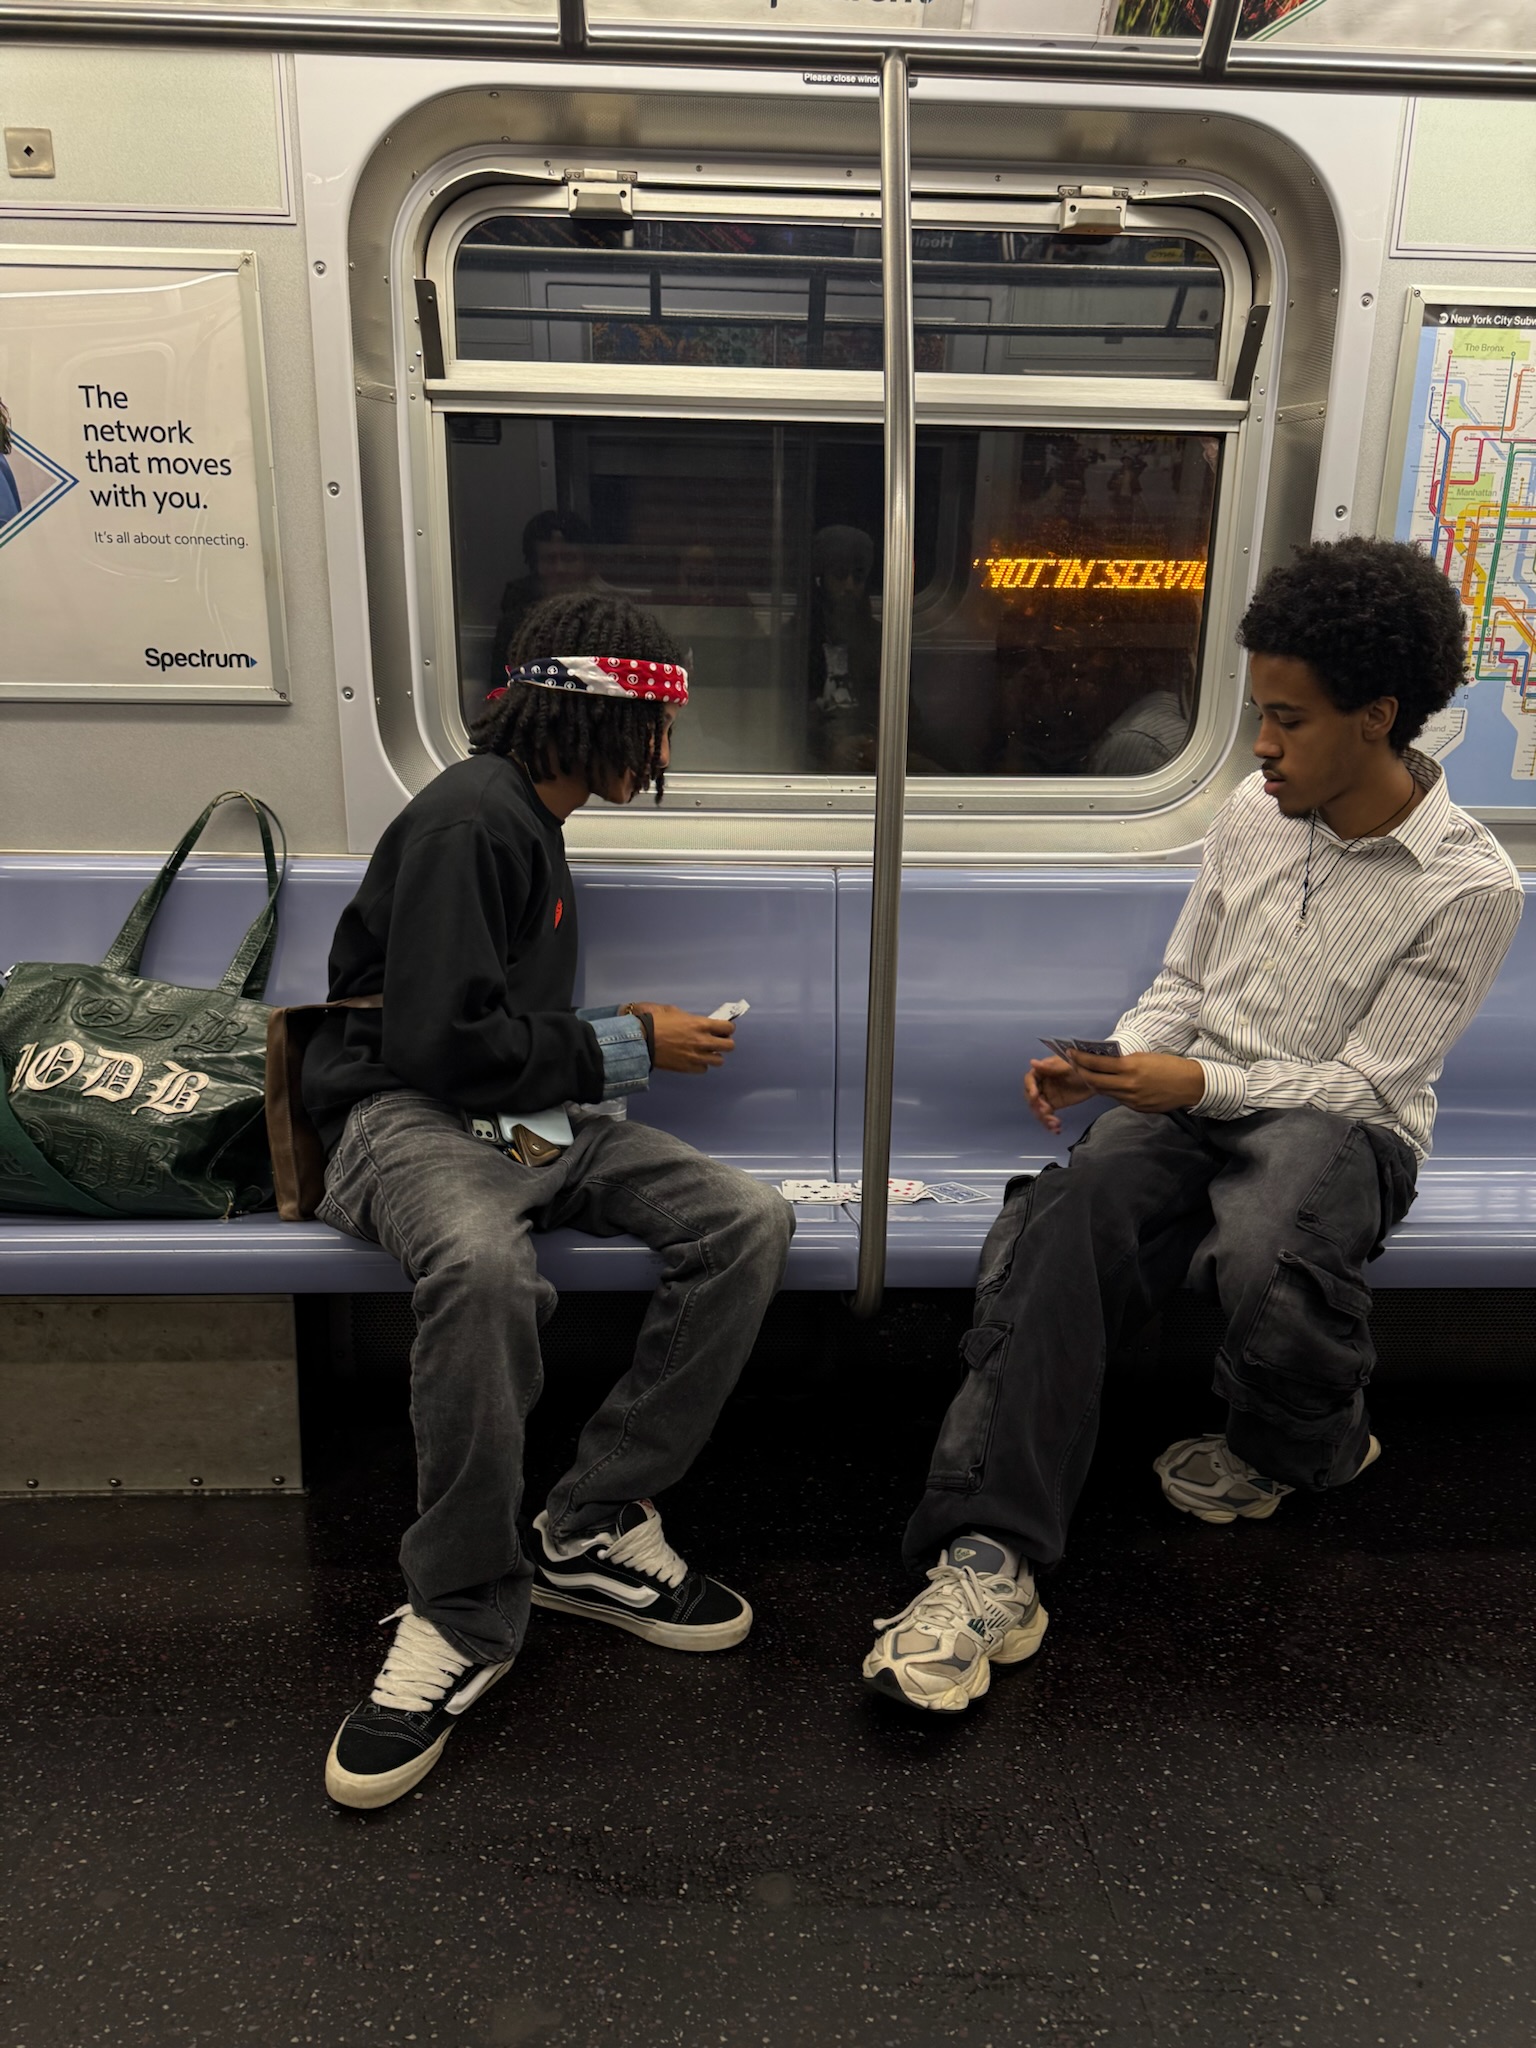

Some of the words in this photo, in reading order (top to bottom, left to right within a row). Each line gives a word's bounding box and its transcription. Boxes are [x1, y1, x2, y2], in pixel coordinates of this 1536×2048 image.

[804, 72, 832, 82] Please
[833, 74, 856, 83] close
[1450, 314, 1471, 324] New
[1472, 314, 1492, 325] York
[1493, 315, 1514, 326] City
[1465, 343, 1479, 351] The
[1481, 343, 1505, 352] Bronx
[78, 384, 128, 409] The
[83, 420, 194, 444] network
[85, 449, 140, 474] that
[147, 457, 232, 476] moves
[90, 483, 147, 508] with
[153, 491, 208, 514] you.
[1456, 488, 1497, 497] Manhattan
[94, 531, 113, 543] It's
[116, 532, 130, 544] all
[133, 532, 171, 544] about
[174, 533, 249, 549] connecting.
[145, 647, 250, 672] Spectrum
